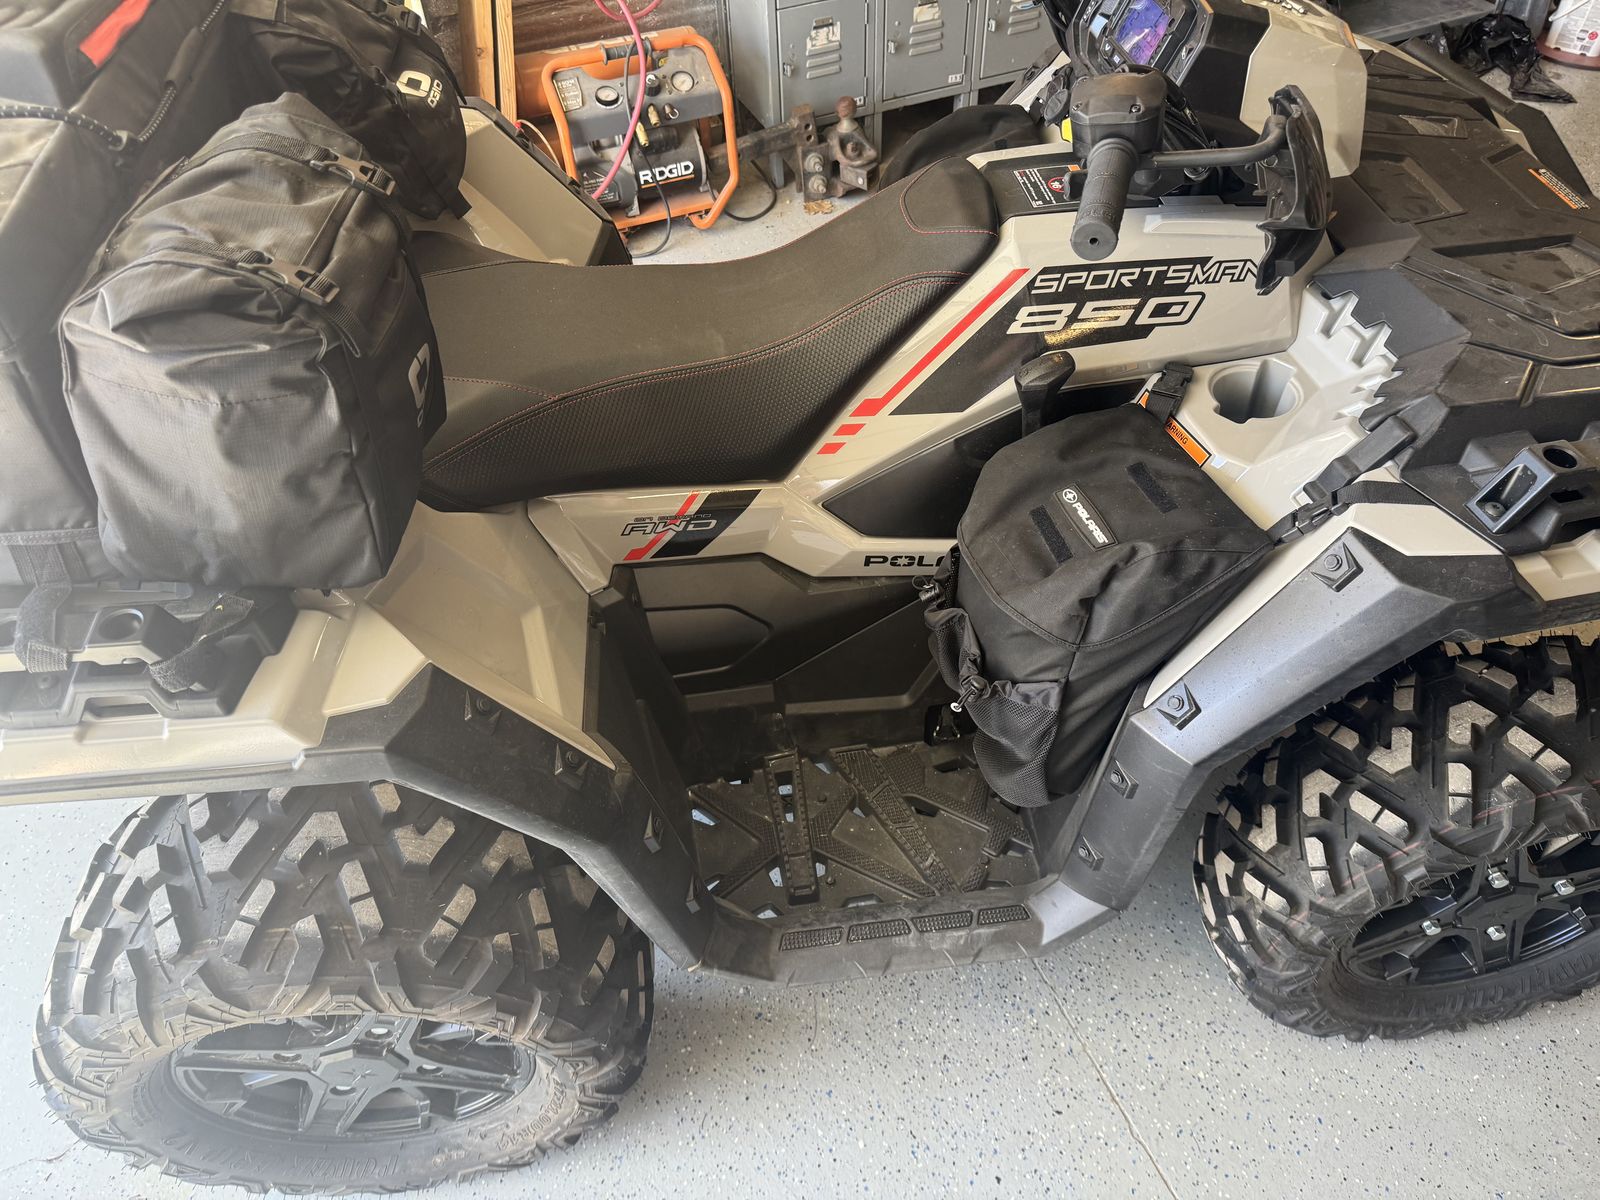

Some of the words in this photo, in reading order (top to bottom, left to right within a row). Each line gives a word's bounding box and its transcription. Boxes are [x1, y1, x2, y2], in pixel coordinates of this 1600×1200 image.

[427, 79, 443, 108] OGIO
[1031, 258, 1258, 295] SPORTSMAN
[1006, 294, 1206, 335] 850
[1166, 421, 1189, 445] ARNING
[620, 519, 718, 537] AWD
[1072, 502, 1109, 543] POLARIS
